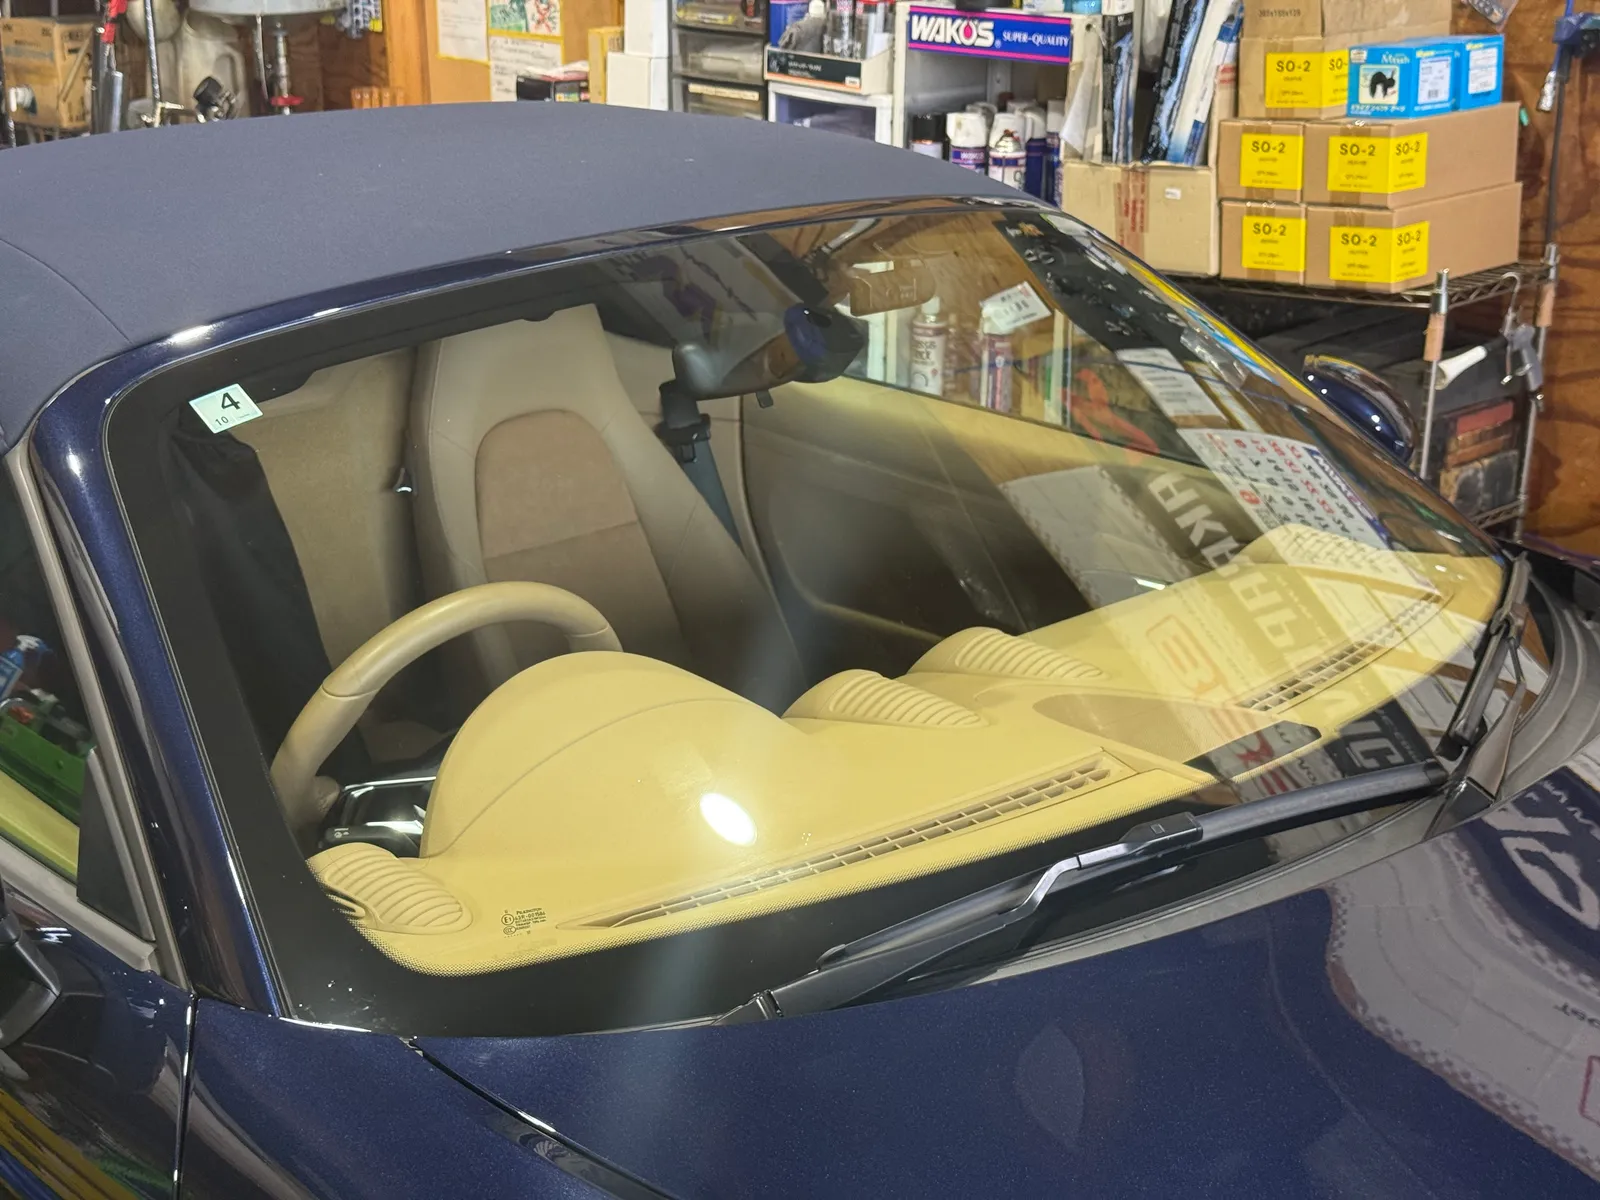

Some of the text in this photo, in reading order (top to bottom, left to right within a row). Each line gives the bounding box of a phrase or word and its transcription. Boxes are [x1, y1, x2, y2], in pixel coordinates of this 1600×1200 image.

[1002, 31, 1069, 47] SUPER-QUALITY
[1276, 60, 1311, 72] SO-2
[1328, 58, 1348, 71] SO-
[1251, 141, 1286, 154] SO-2
[1339, 143, 1376, 156] SO-2
[1395, 141, 1421, 156] SO-2
[1252, 222, 1287, 236] SO-2
[1340, 233, 1377, 246] SO-2
[1396, 230, 1421, 246] SO-2
[221, 392, 241, 410] 4
[215, 416, 229, 426] 10
